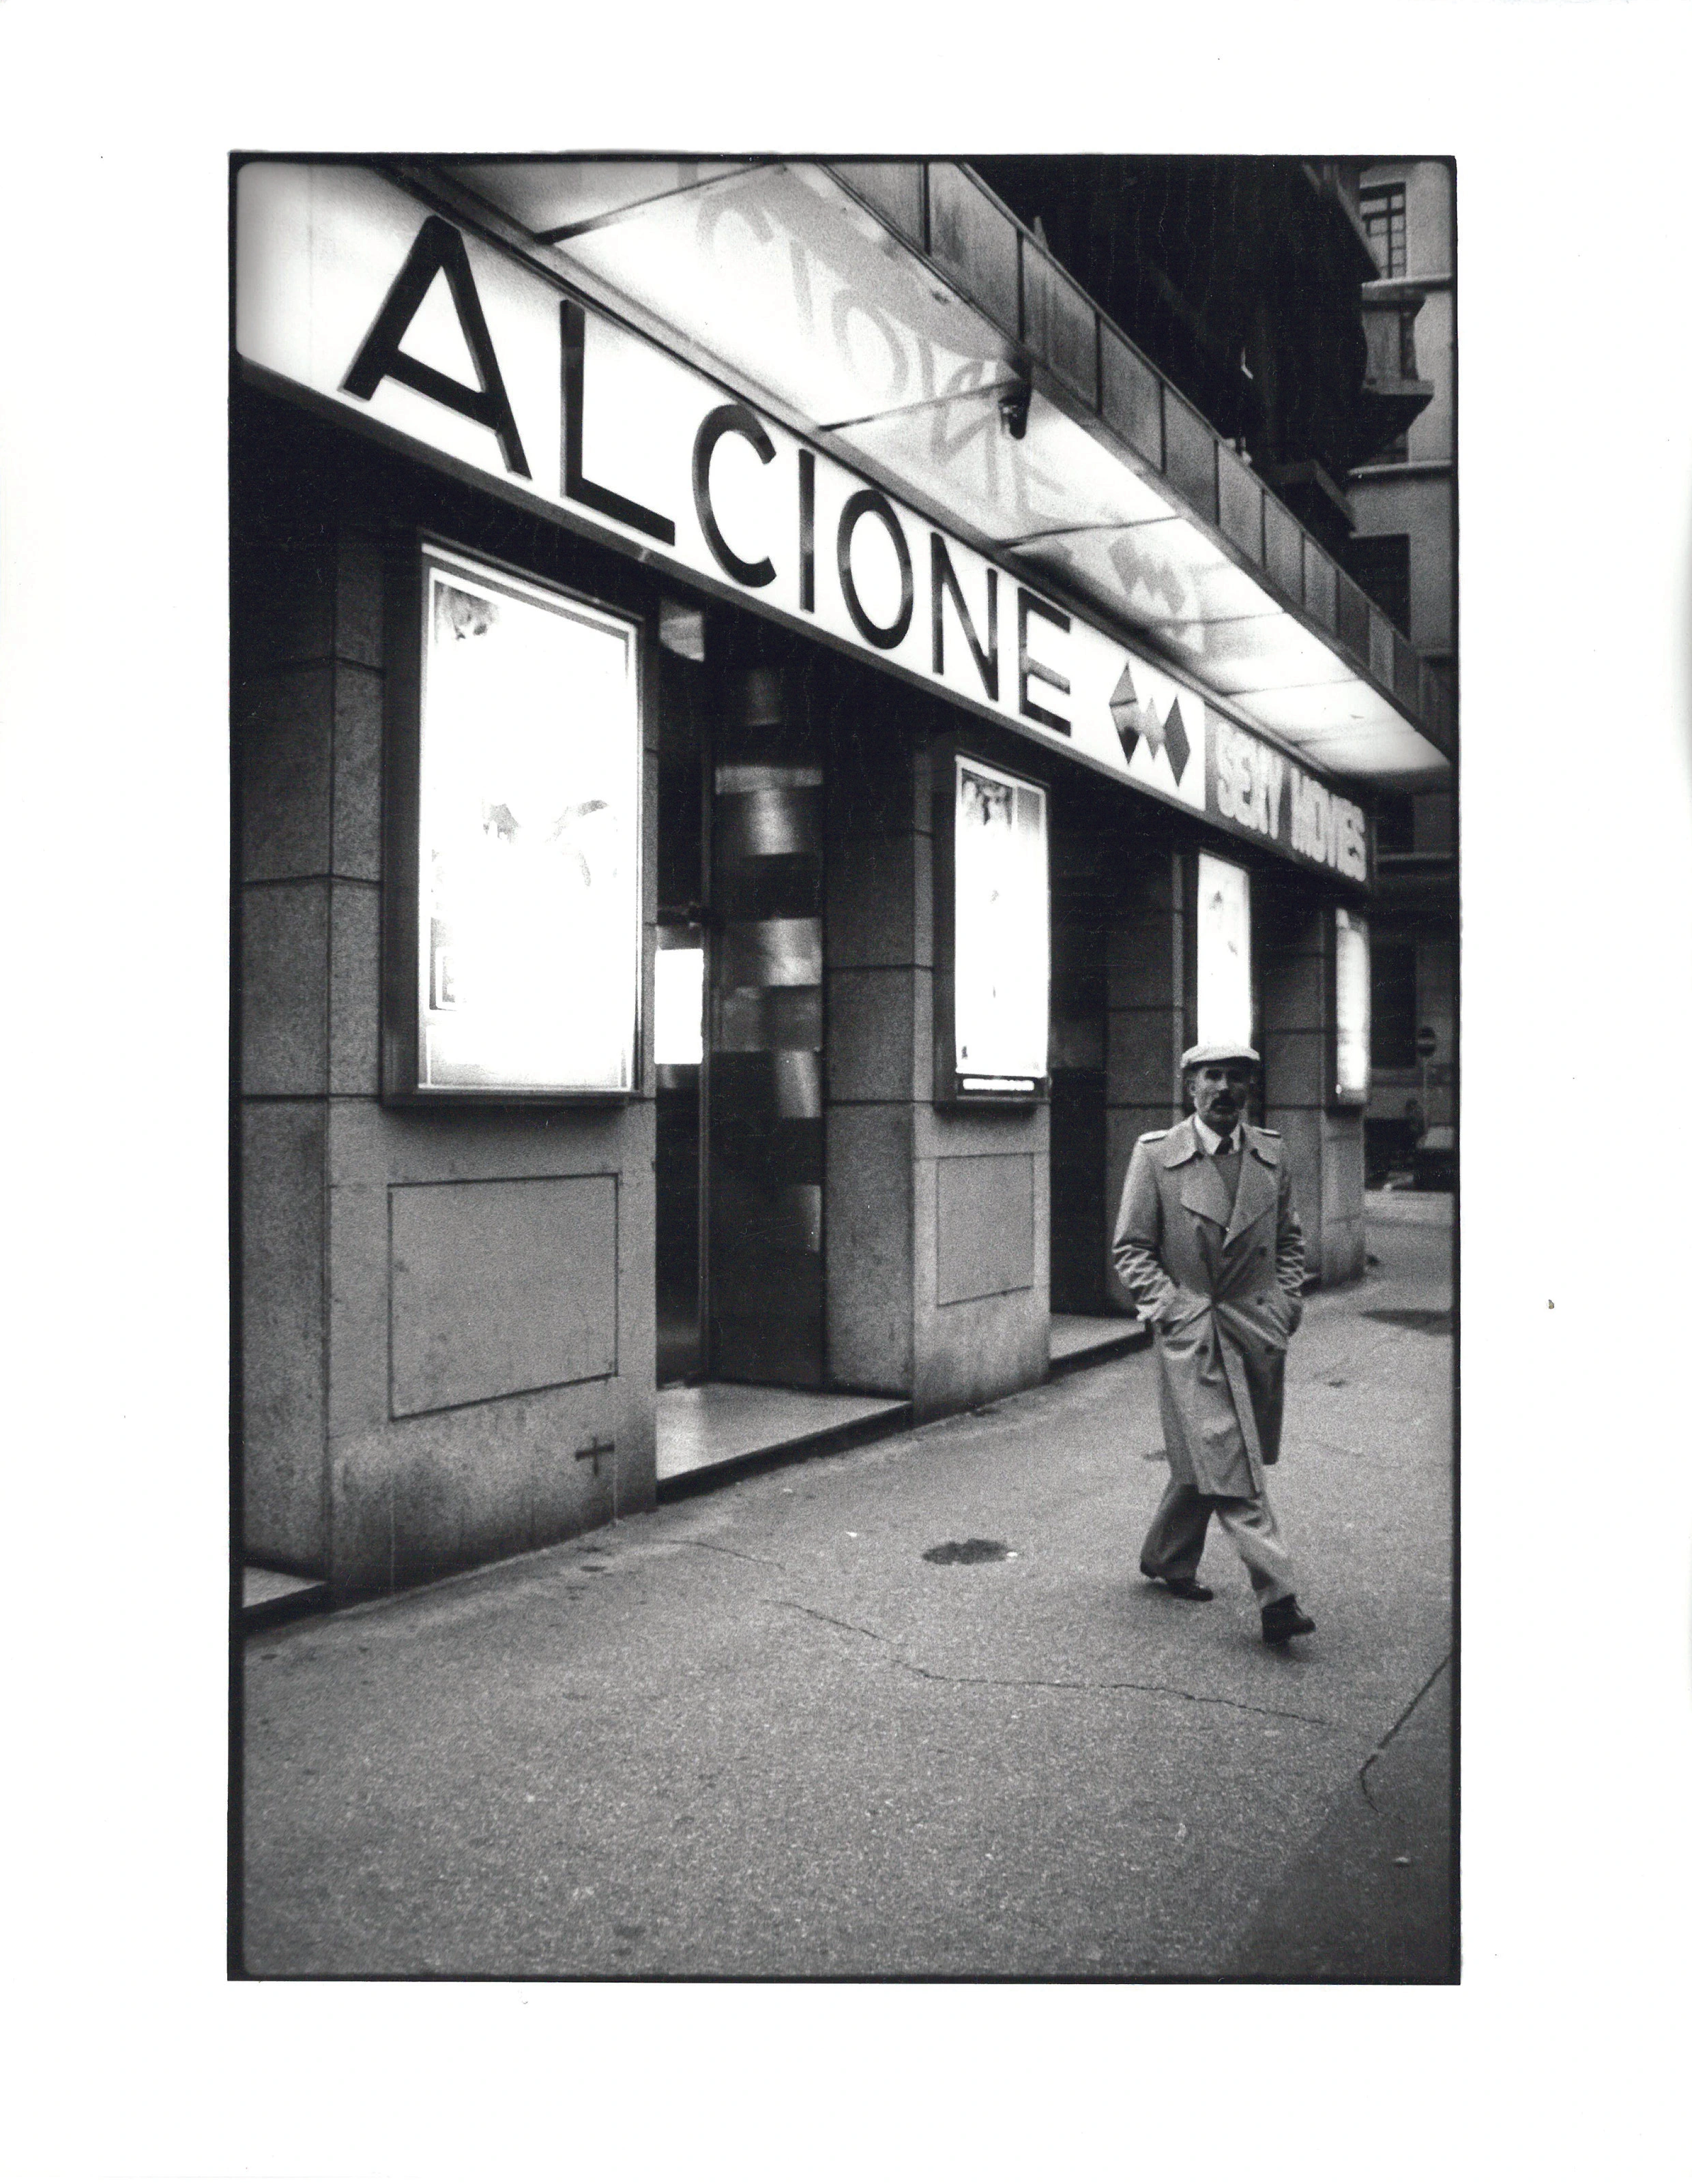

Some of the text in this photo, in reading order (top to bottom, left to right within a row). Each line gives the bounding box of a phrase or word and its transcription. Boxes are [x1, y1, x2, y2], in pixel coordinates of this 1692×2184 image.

[337, 215, 1072, 737] ALCIONE
[1216, 720, 1367, 882] SEXY MOVIES
